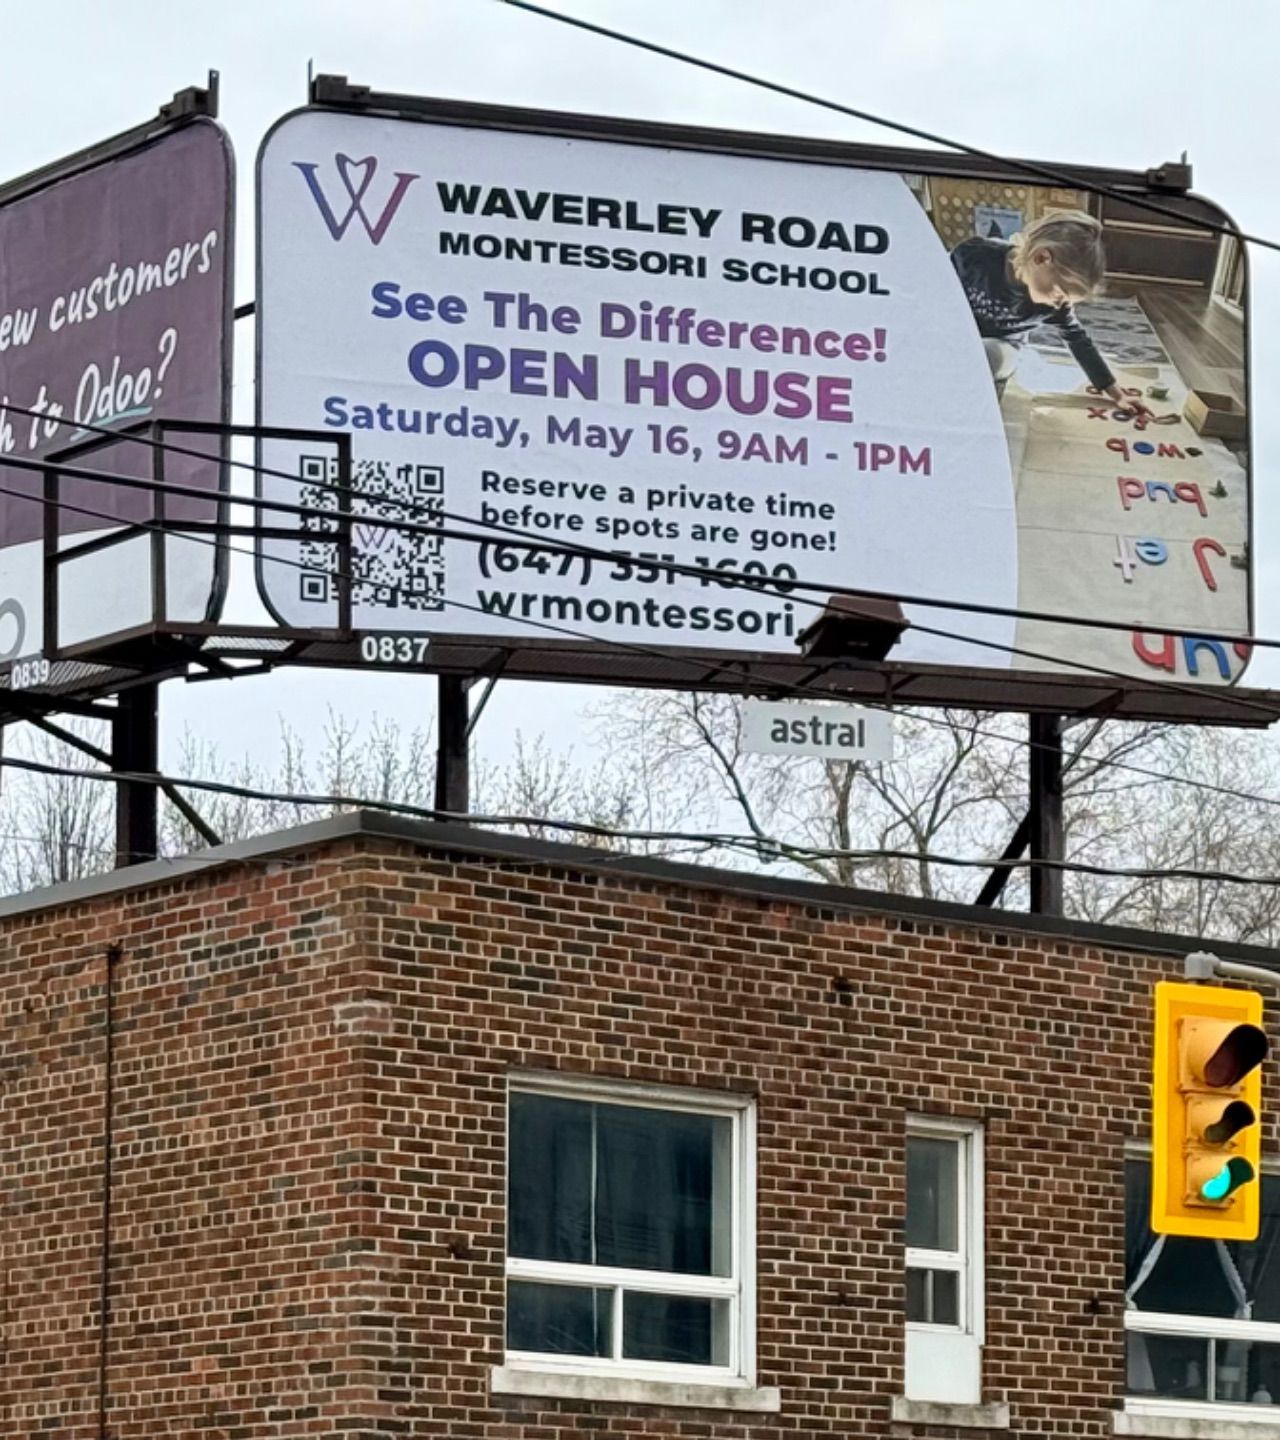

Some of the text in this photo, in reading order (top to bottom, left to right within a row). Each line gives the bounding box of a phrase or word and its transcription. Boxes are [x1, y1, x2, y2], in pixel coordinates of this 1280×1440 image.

[436, 181, 890, 255] WAVERLEY ROAD
[49, 230, 217, 332] customers
[439, 231, 891, 296] MONTESSORI SCHOOL
[371, 281, 888, 363] See The Difference!
[28, 385, 64, 450] to
[74, 327, 178, 432] Odoo?
[408, 339, 854, 423] OPEN HOUSE
[323, 396, 932, 476] Saturday, May 16, 9AM - 1PM
[481, 471, 835, 520] Reserve a private time
[481, 502, 837, 553] before spots are gone!
[478, 539, 592, 586] (647)
[11, 658, 50, 691] 0839
[361, 636, 429, 662] 0837
[771, 715, 865, 748] astral
